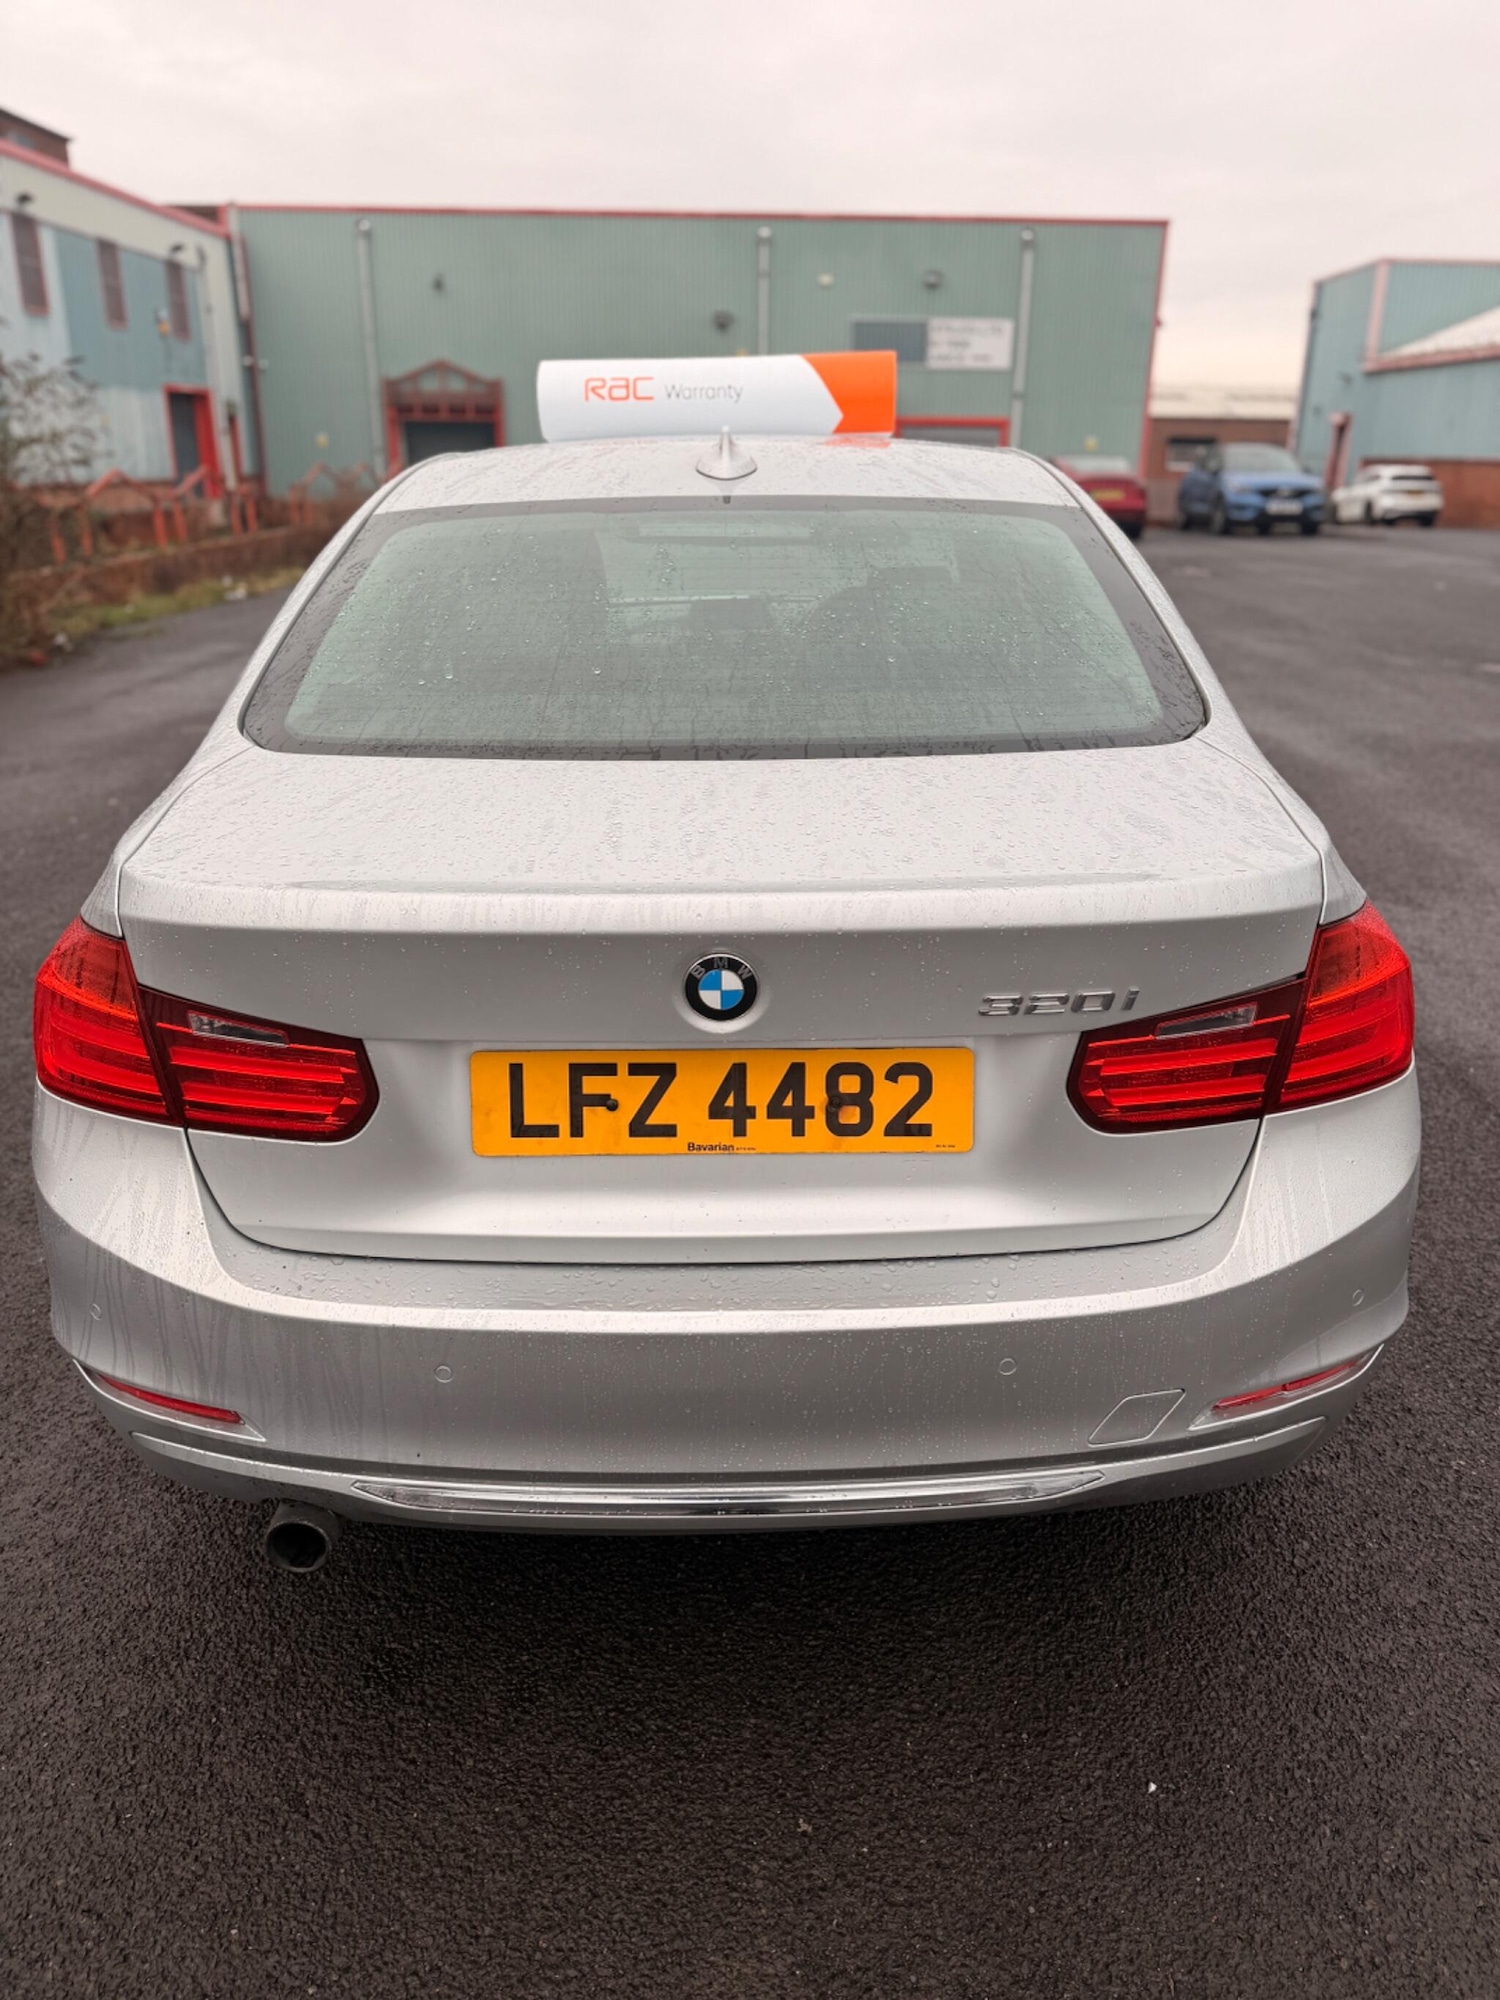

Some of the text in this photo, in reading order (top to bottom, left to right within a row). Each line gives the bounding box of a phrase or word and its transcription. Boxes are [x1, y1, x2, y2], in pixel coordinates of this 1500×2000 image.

[665, 383, 744, 404] Warranty
[690, 957, 753, 980] BMW
[978, 986, 1140, 1016] 320i
[508, 1061, 934, 1139] LFZ 4482
[687, 1141, 735, 1152] Bavarian
